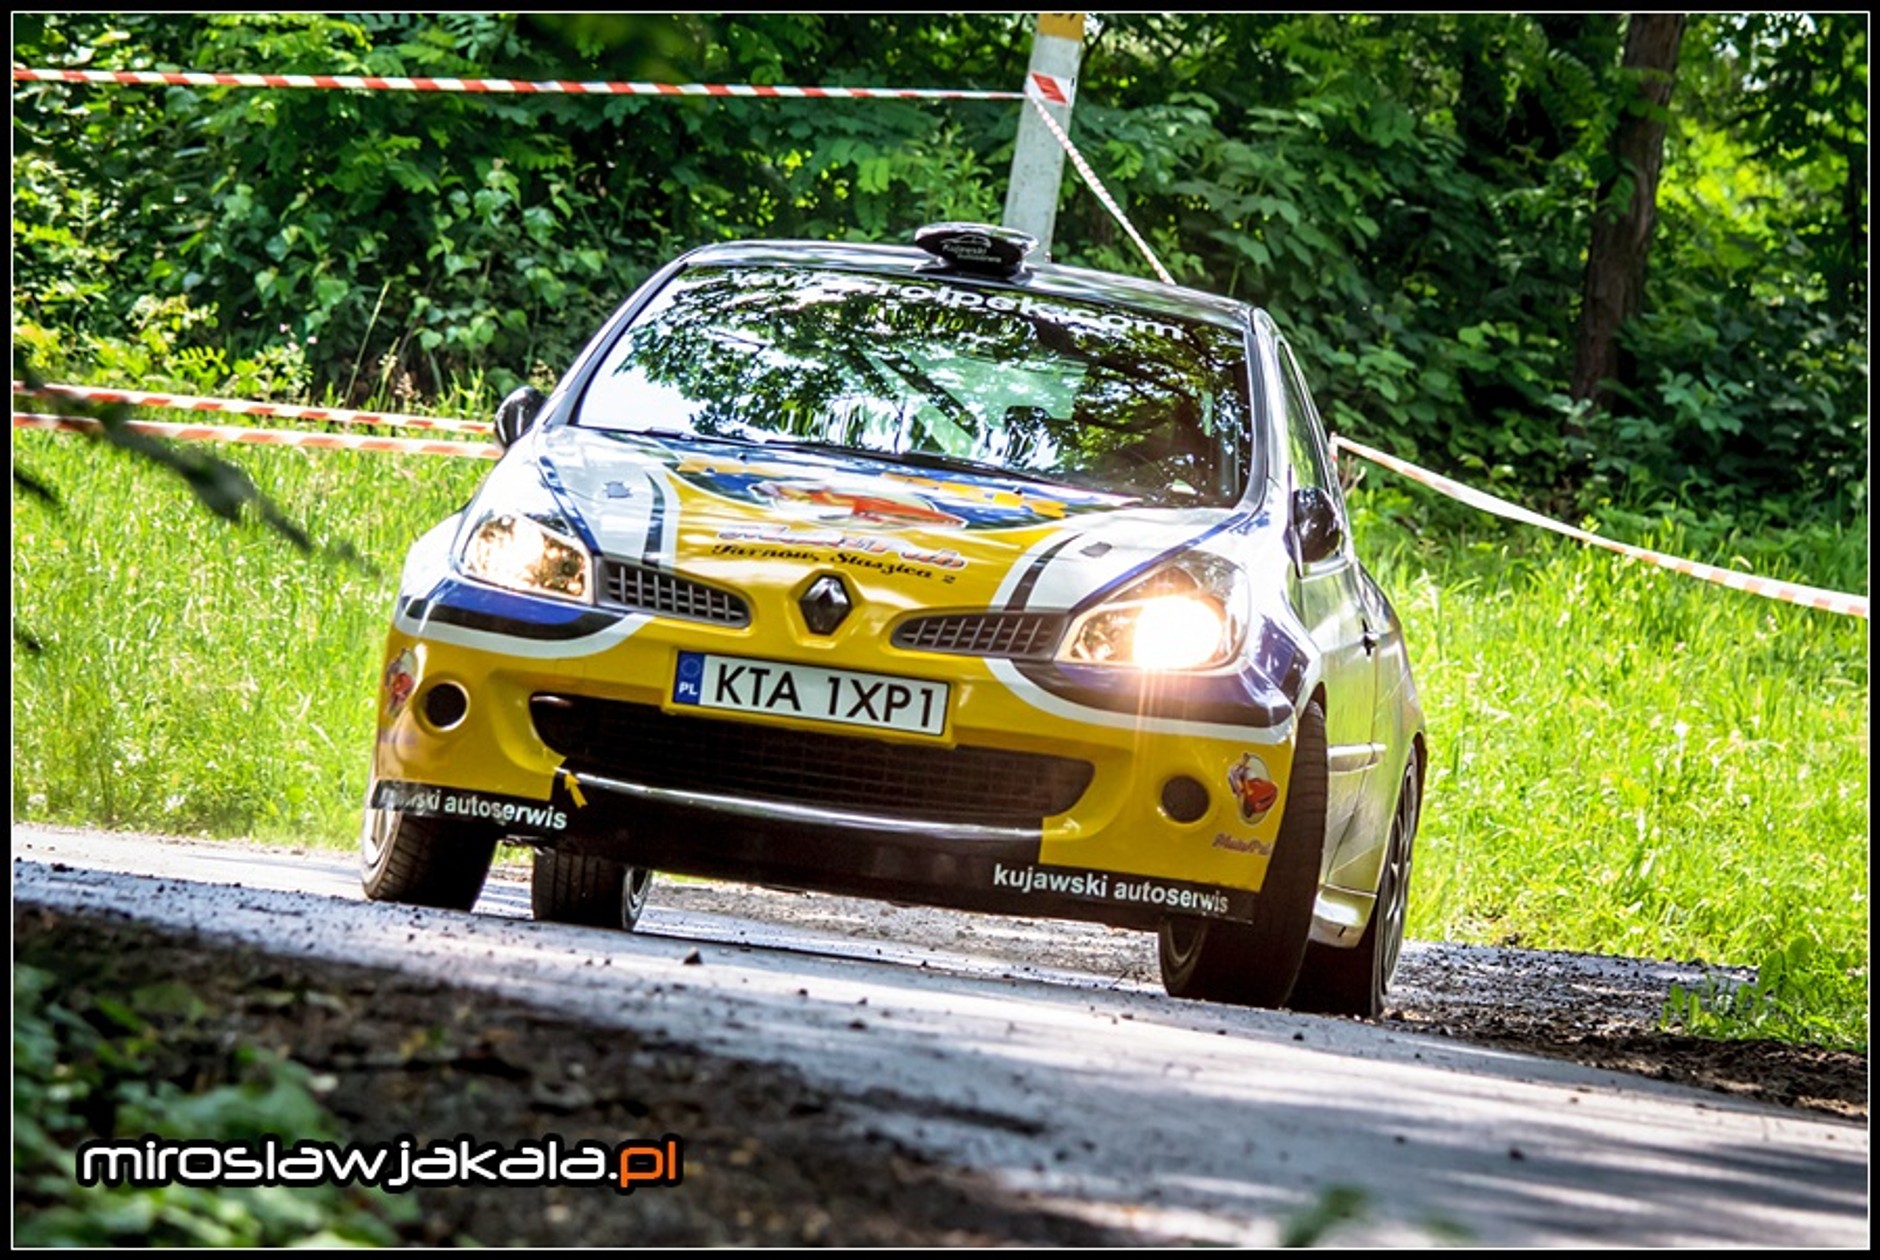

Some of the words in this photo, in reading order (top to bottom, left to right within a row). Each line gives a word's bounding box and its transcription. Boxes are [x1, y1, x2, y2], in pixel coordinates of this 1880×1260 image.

[679, 681, 698, 696] PL
[714, 662, 802, 712] KTA
[827, 675, 934, 728] 1XP1
[443, 793, 568, 830] autoserwis
[992, 862, 1109, 898] kujawski
[1112, 879, 1229, 914] autoserwis
